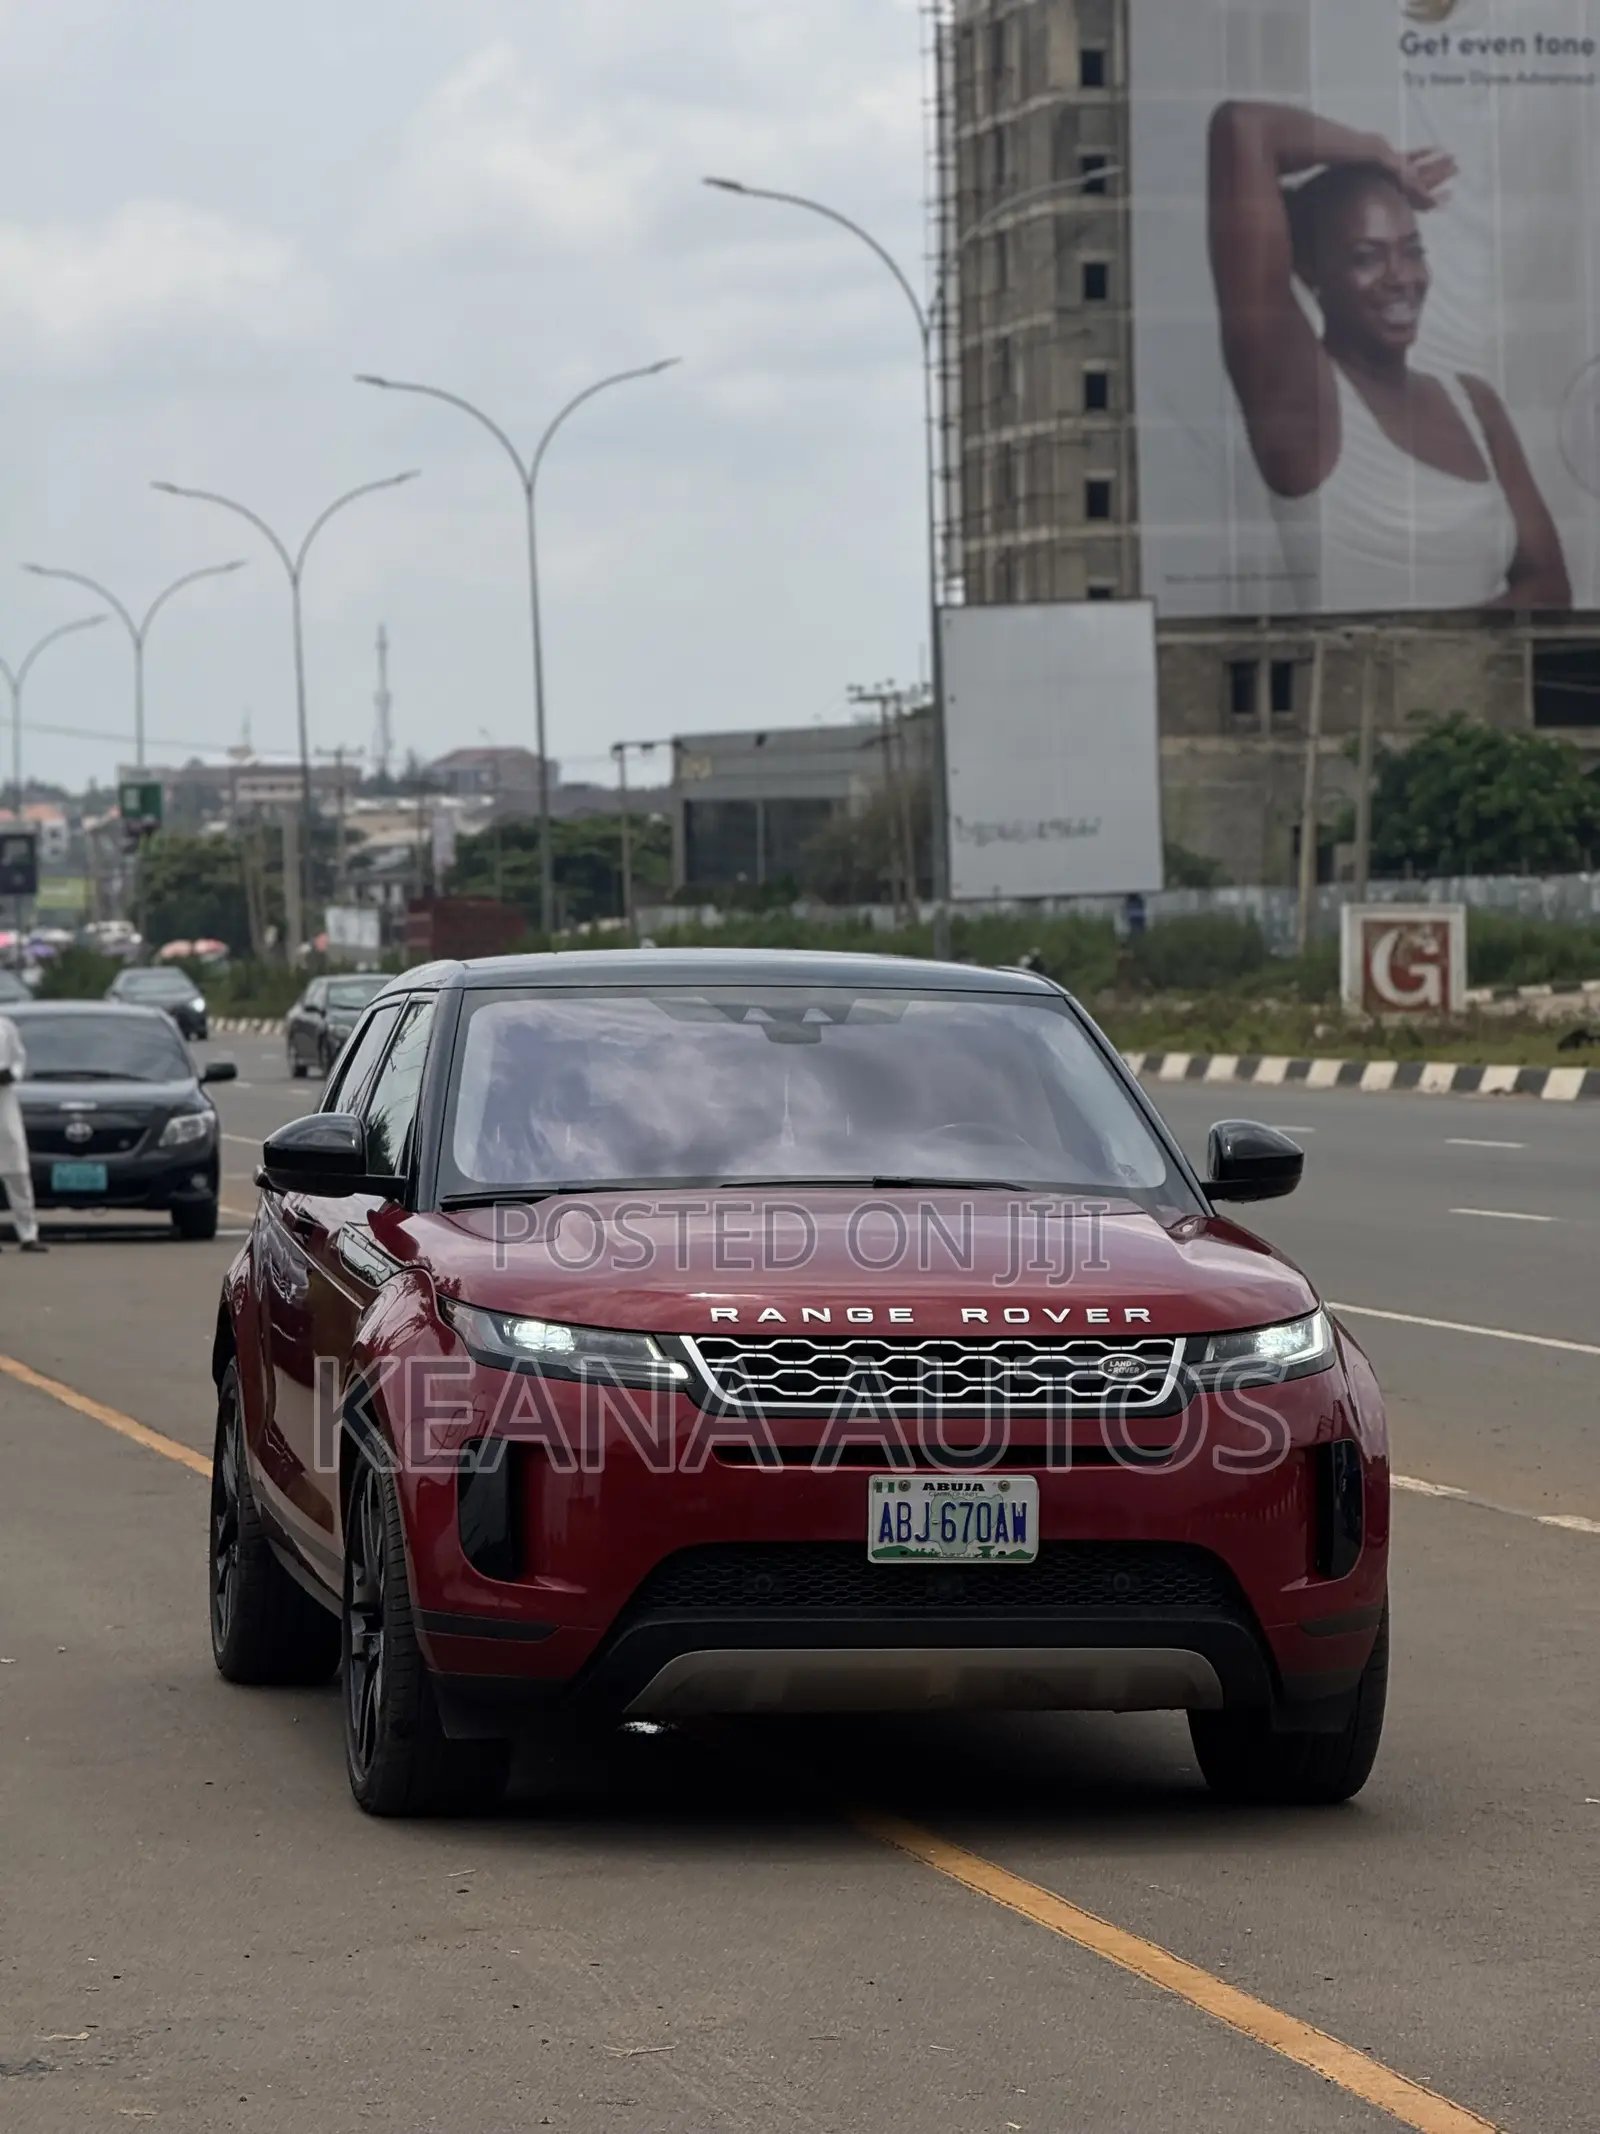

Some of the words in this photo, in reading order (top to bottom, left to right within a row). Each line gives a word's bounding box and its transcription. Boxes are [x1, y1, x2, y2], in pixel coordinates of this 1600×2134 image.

[1400, 31, 1449, 57] Get
[1458, 37, 1526, 56] even
[1535, 32, 1595, 57] tone
[1371, 927, 1442, 1006] G
[711, 1307, 914, 1323] RANGE
[961, 1307, 1151, 1323] ROVER
[922, 1482, 985, 1492] ABUJA
